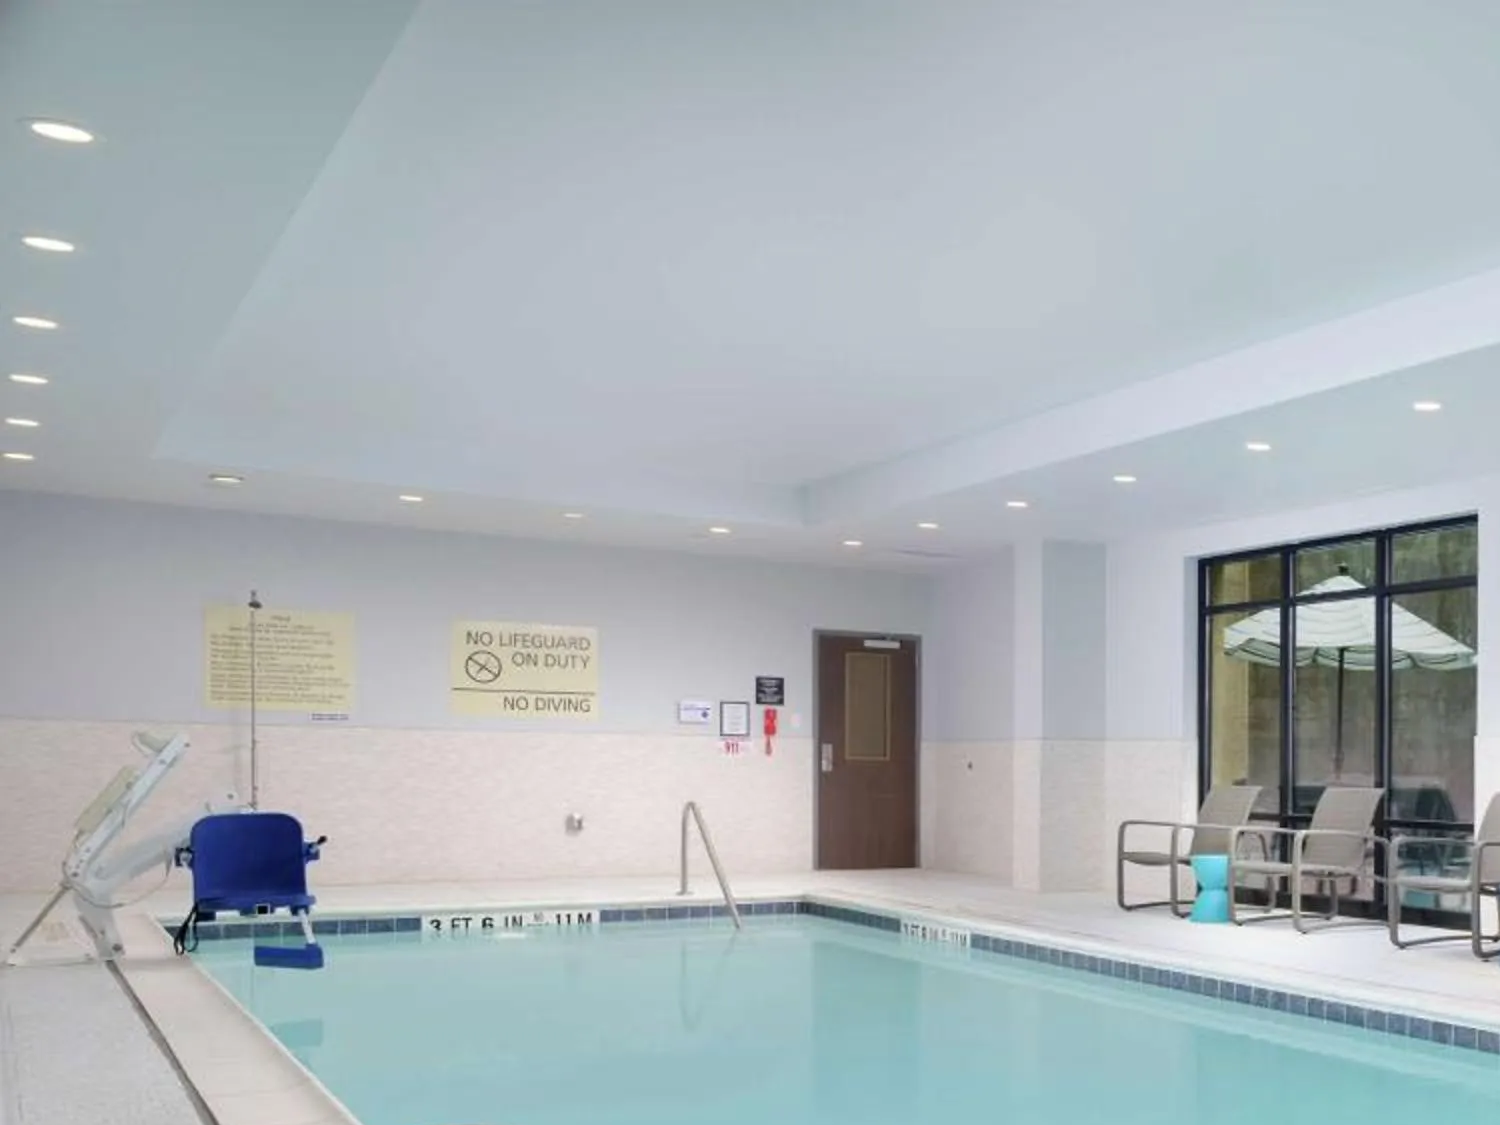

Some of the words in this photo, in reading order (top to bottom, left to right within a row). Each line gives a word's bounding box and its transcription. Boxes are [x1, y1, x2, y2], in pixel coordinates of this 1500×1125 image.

[466, 630, 493, 647] NO
[499, 632, 591, 651] LIFEGUARD
[511, 651, 538, 667] ON
[544, 653, 590, 669] DUTY
[503, 696, 529, 711] NO
[535, 697, 591, 713] DIVING
[451, 917, 472, 928] FT
[482, 916, 494, 928] 6
[504, 915, 523, 927] IN
